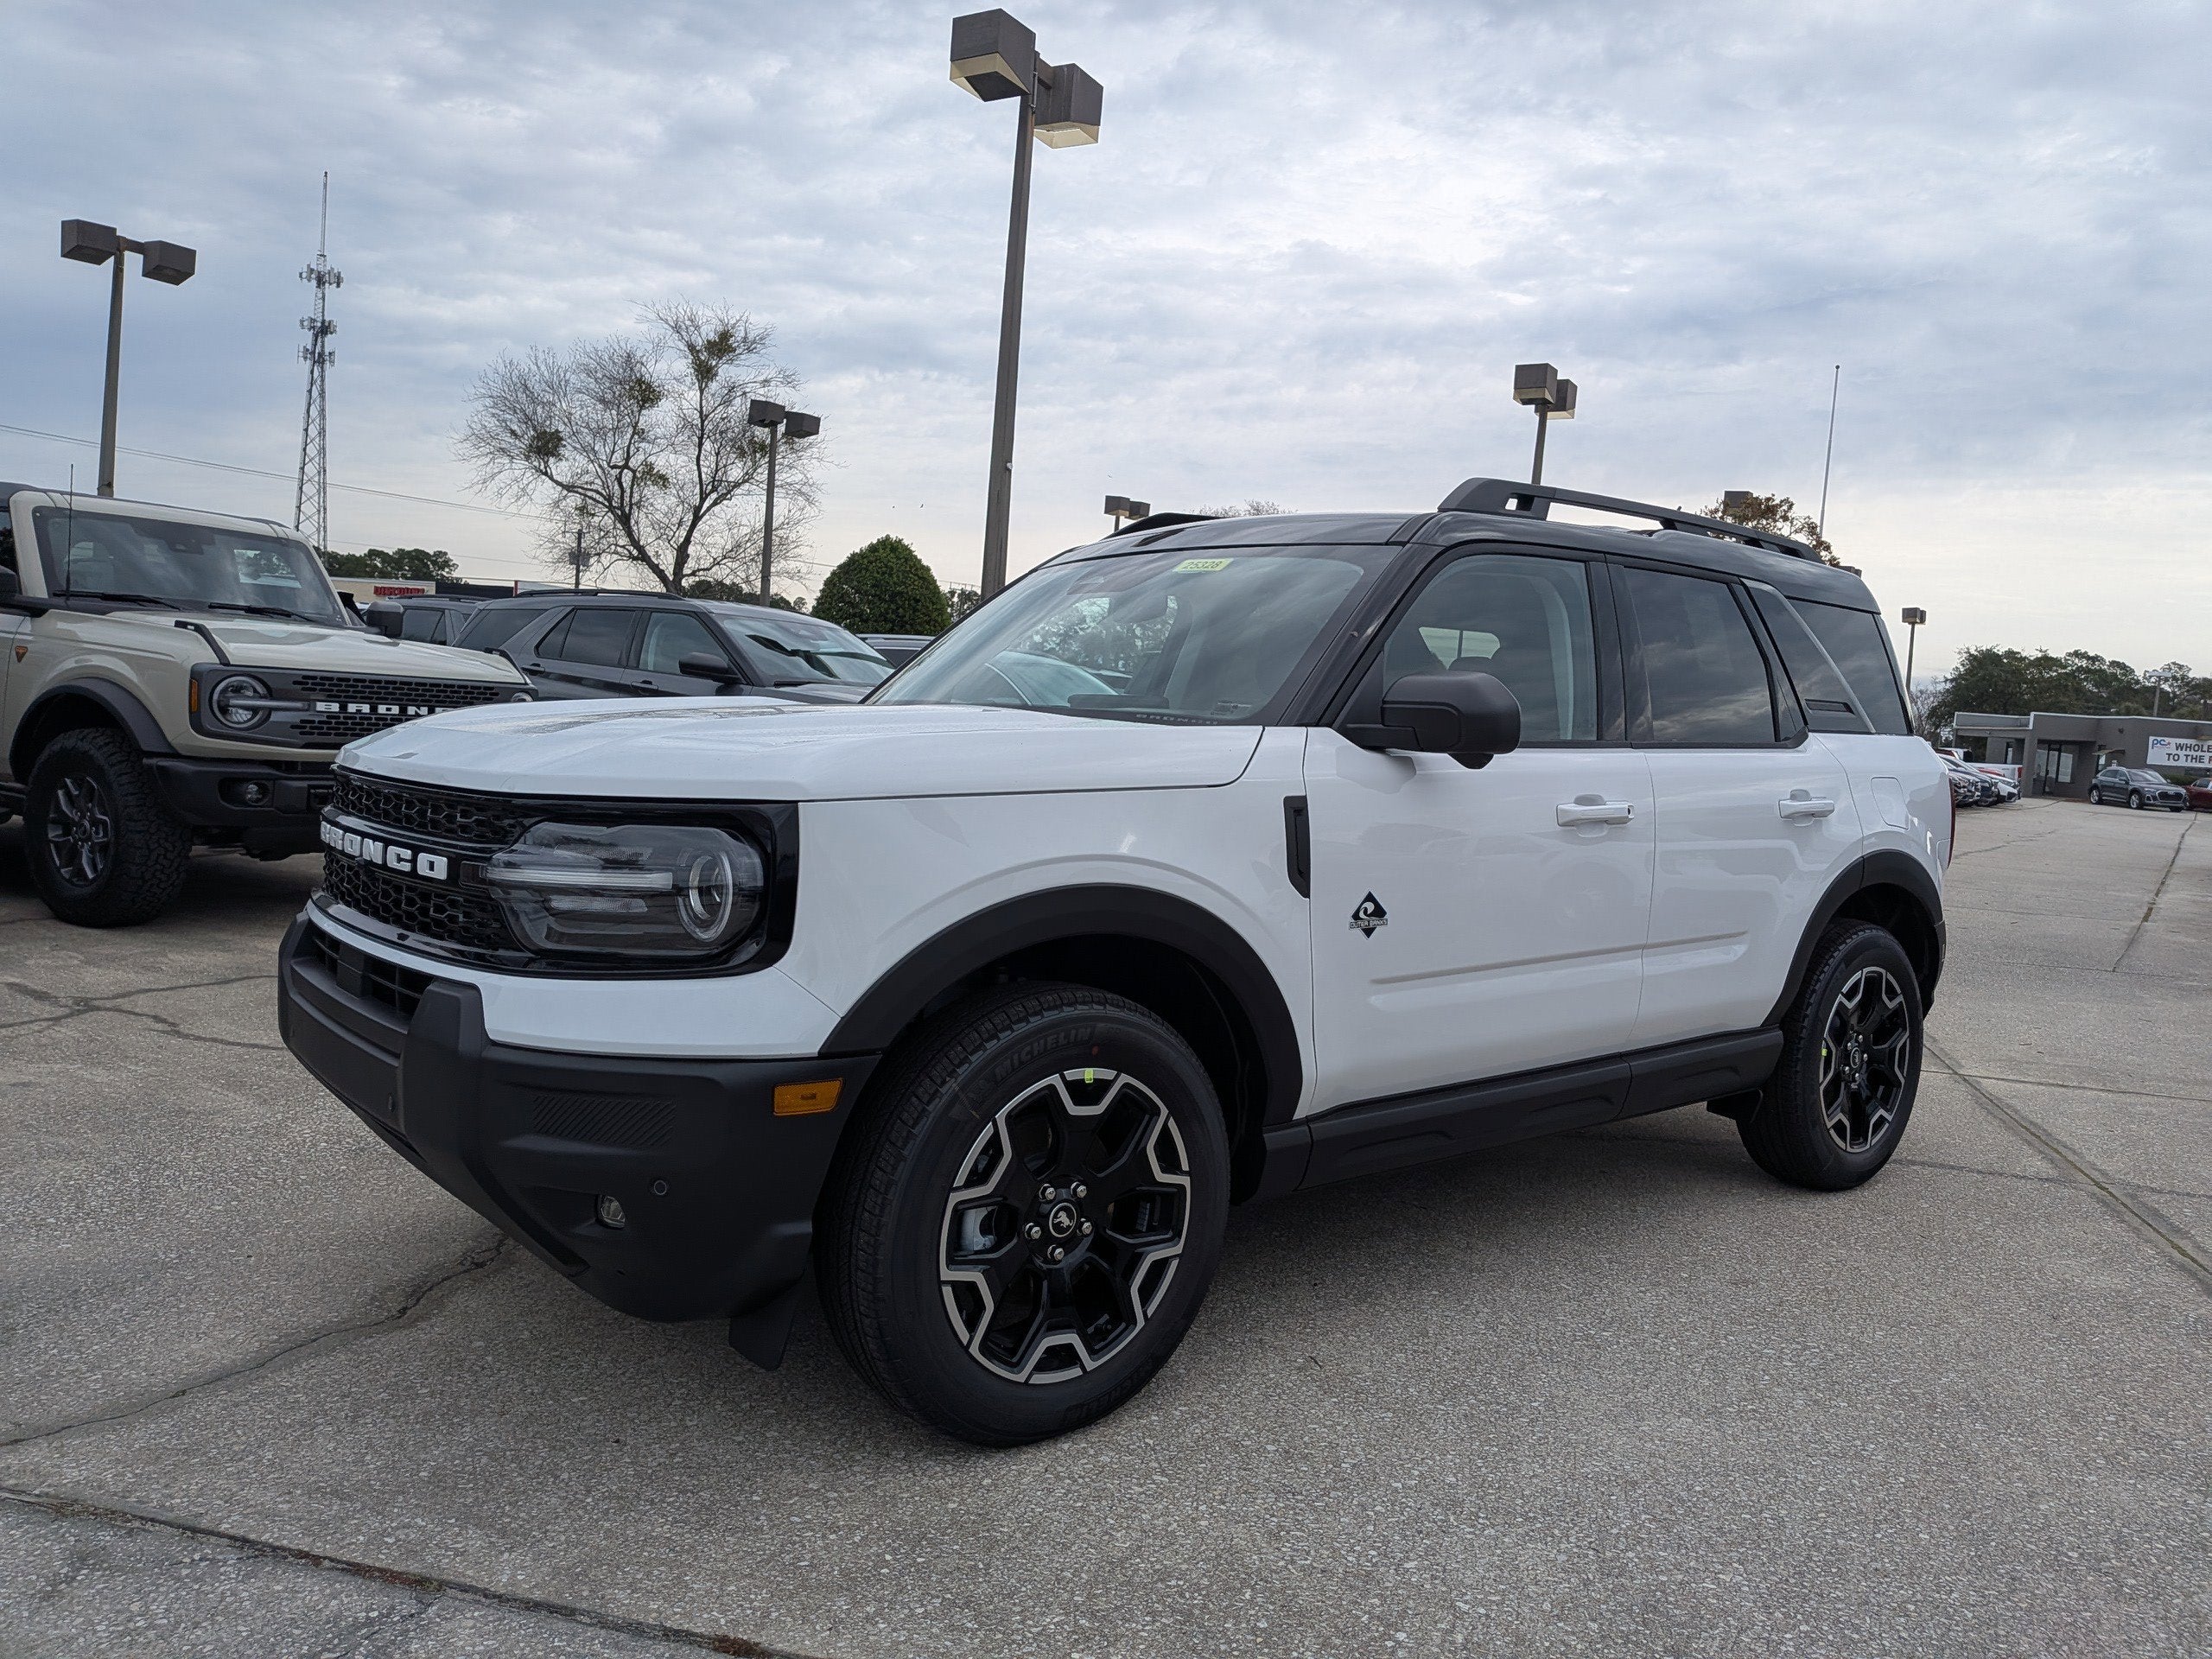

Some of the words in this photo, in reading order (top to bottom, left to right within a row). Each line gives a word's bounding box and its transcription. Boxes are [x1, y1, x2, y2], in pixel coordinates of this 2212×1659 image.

[1182, 561, 1223, 569] 25328
[2166, 753, 2180, 761] TO
[2183, 754, 2205, 764] THE
[321, 822, 448, 880] BRONCO
[995, 1028, 1091, 1079] MICHELIN
